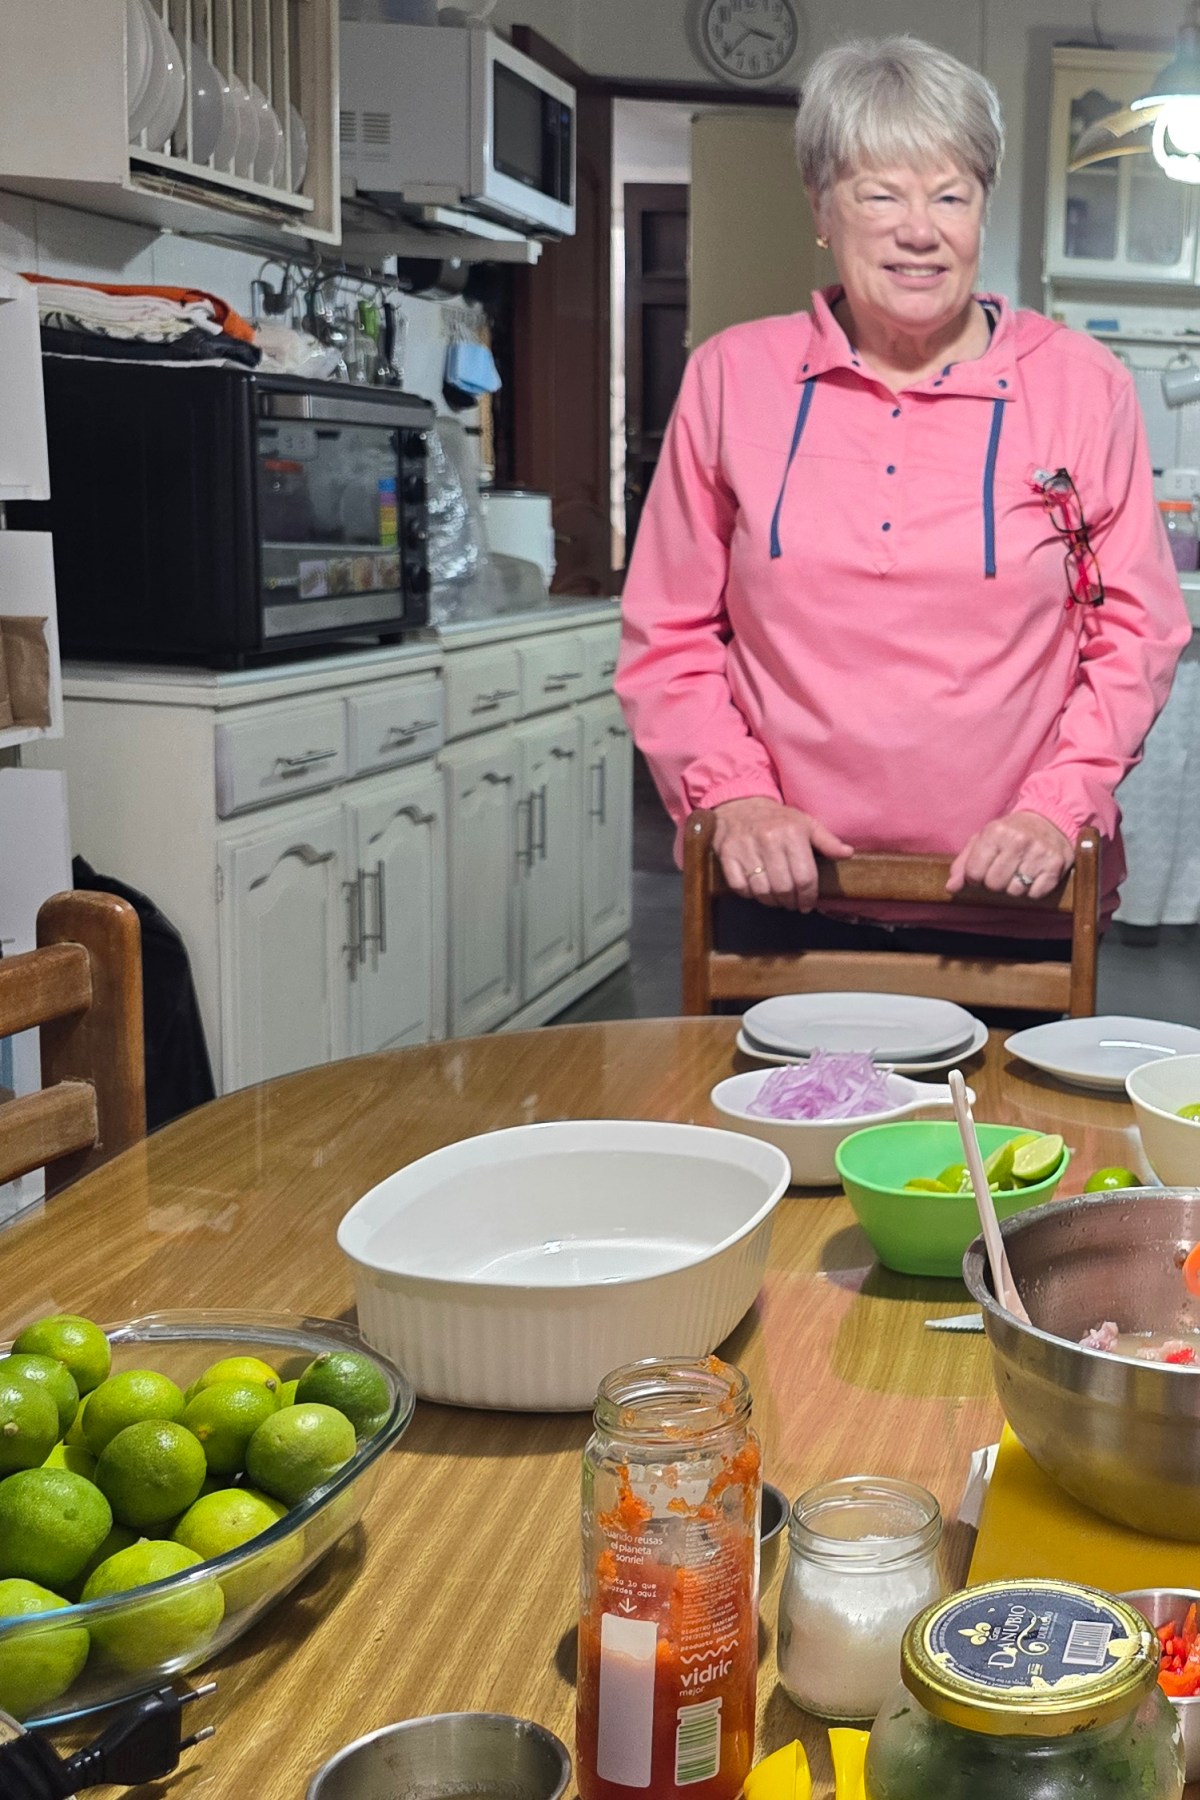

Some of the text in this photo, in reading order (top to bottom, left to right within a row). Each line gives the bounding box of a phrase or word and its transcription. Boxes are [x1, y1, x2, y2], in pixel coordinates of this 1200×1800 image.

[635, 1536, 664, 1546] reusas
[610, 1541, 651, 1555] el planeta
[628, 1579, 638, 1588] lo
[987, 1605, 1027, 1669] DANUBIO
[679, 1686, 705, 1697] mejor
